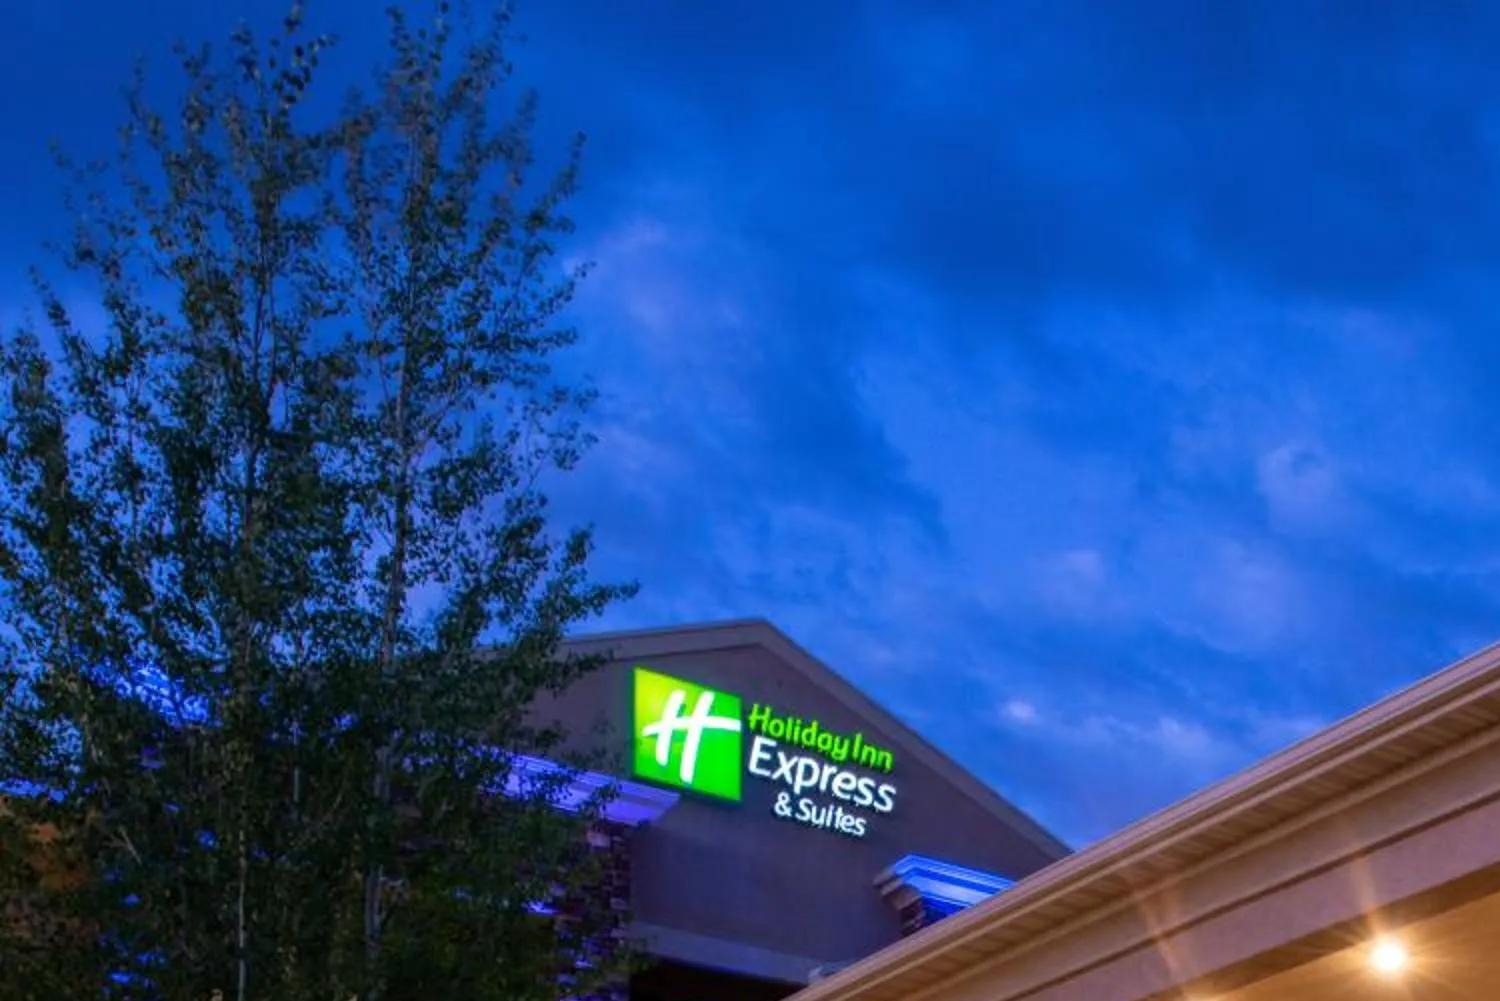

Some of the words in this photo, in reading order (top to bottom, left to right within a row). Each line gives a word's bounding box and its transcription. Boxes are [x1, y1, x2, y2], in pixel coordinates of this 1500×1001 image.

[748, 703, 850, 761] Holiday
[852, 732, 893, 773] Inn
[748, 735, 896, 812] Express
[774, 791, 792, 817] &
[794, 798, 867, 836] Suites
